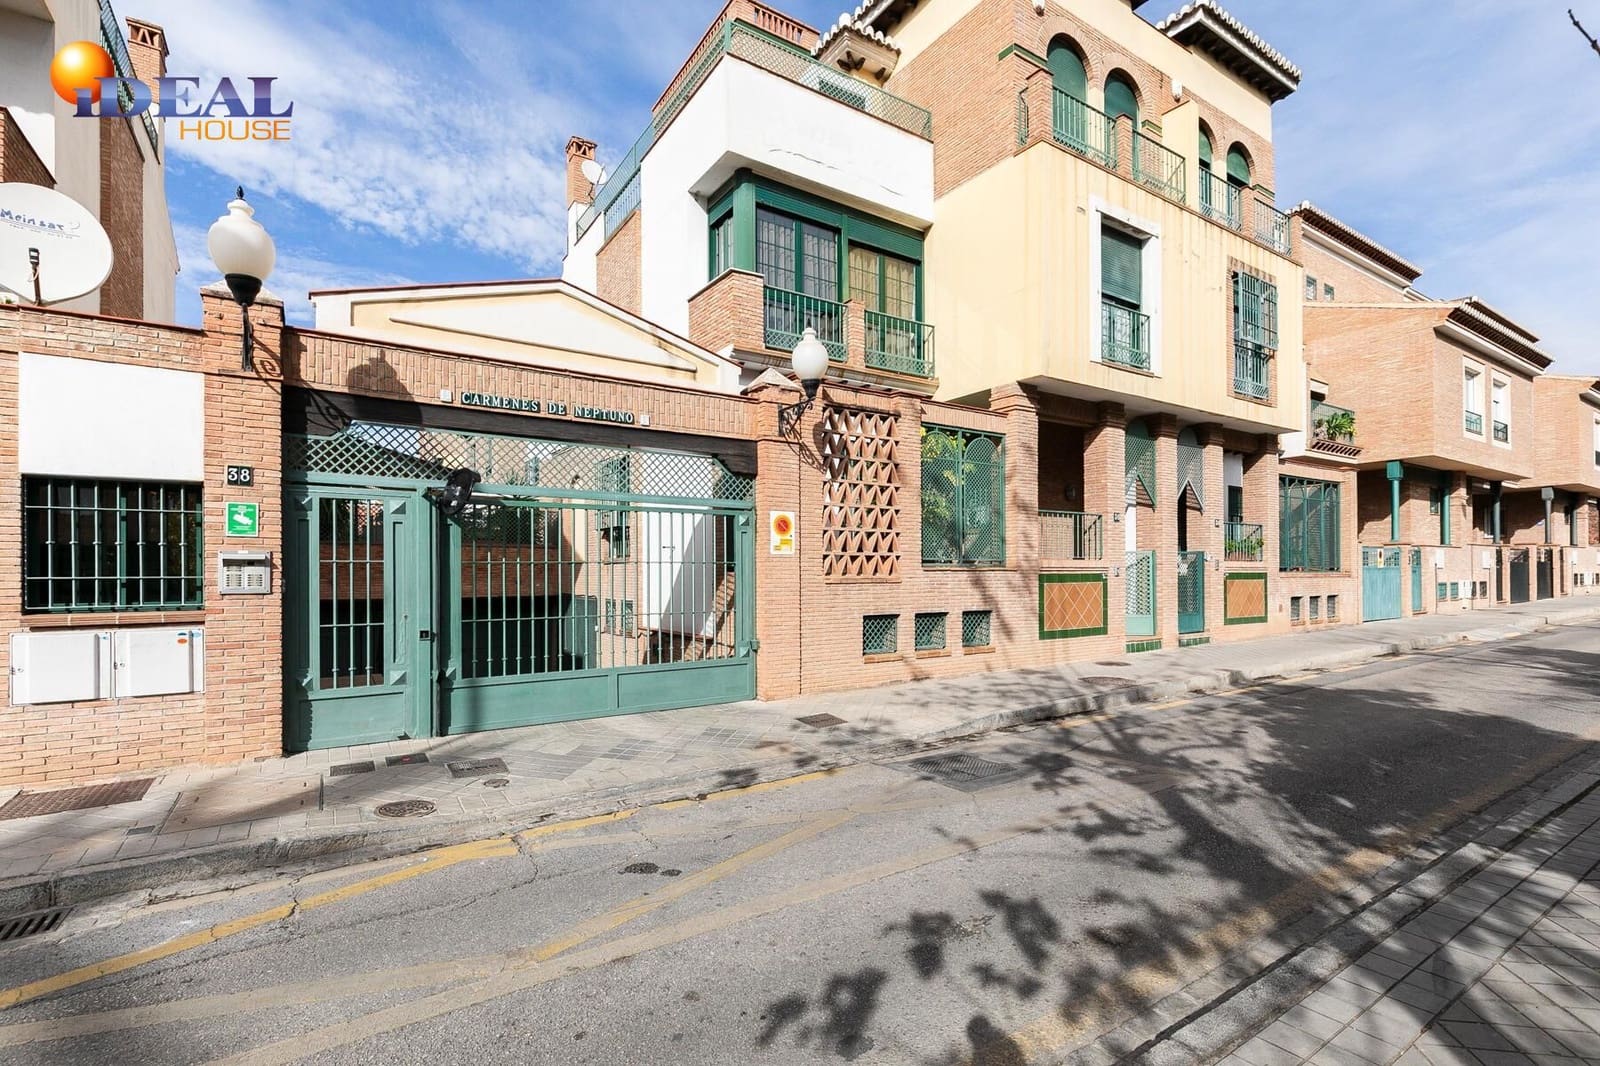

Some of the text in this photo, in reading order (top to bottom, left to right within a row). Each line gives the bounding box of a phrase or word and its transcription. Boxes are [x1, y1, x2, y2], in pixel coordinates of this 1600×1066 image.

[461, 392, 634, 424] CARMENES DE NEPTUNO
[228, 467, 249, 482] 38
